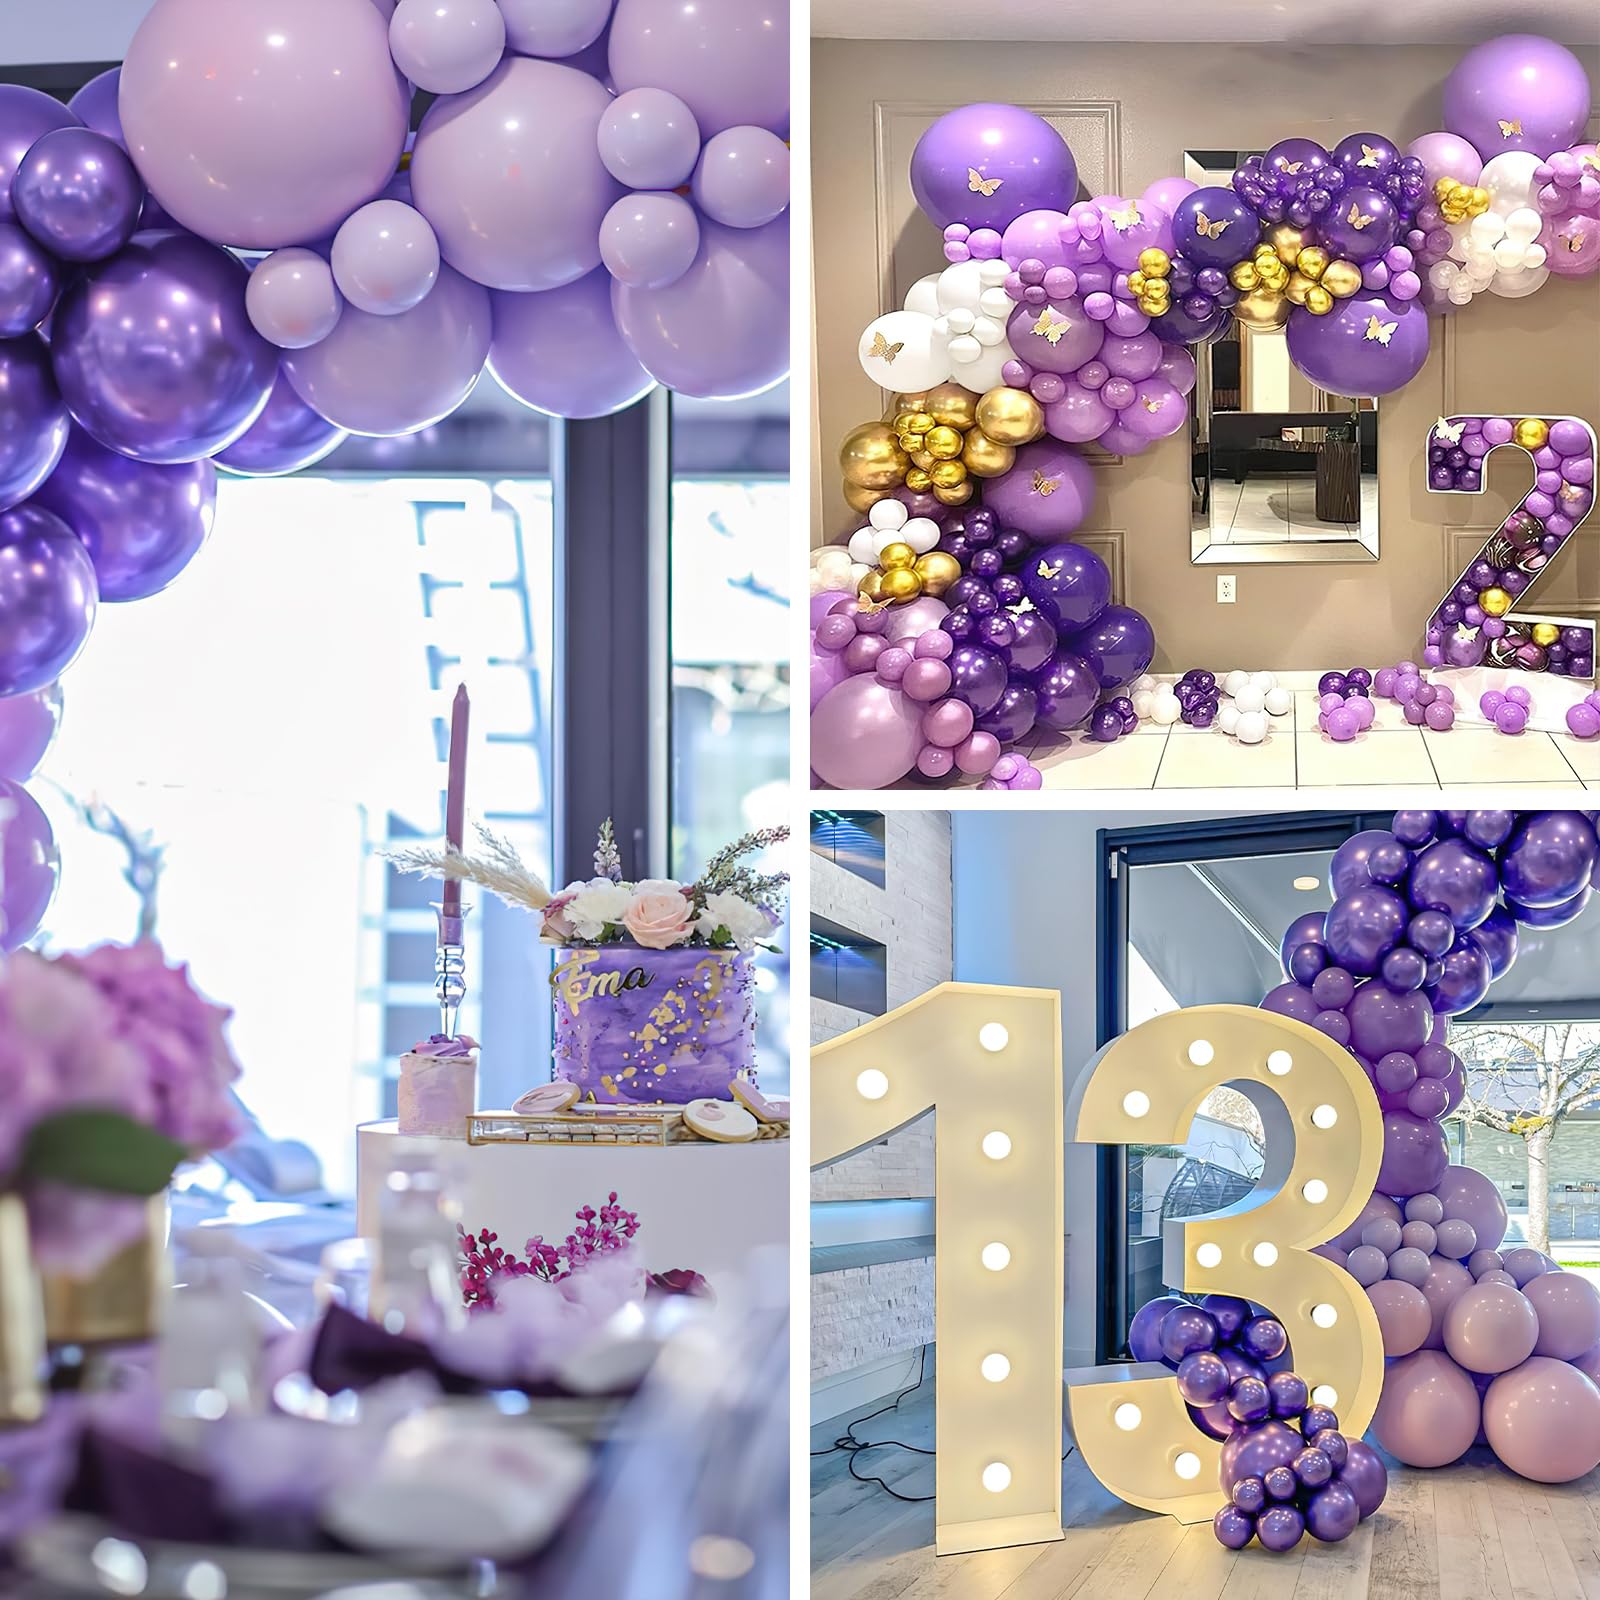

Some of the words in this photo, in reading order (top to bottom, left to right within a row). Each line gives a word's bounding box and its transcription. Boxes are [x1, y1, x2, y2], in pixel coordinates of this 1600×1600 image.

[1425, 414, 1598, 680] 2
[549, 949, 656, 1017] Ema
[810, 981, 1384, 1557] 13
